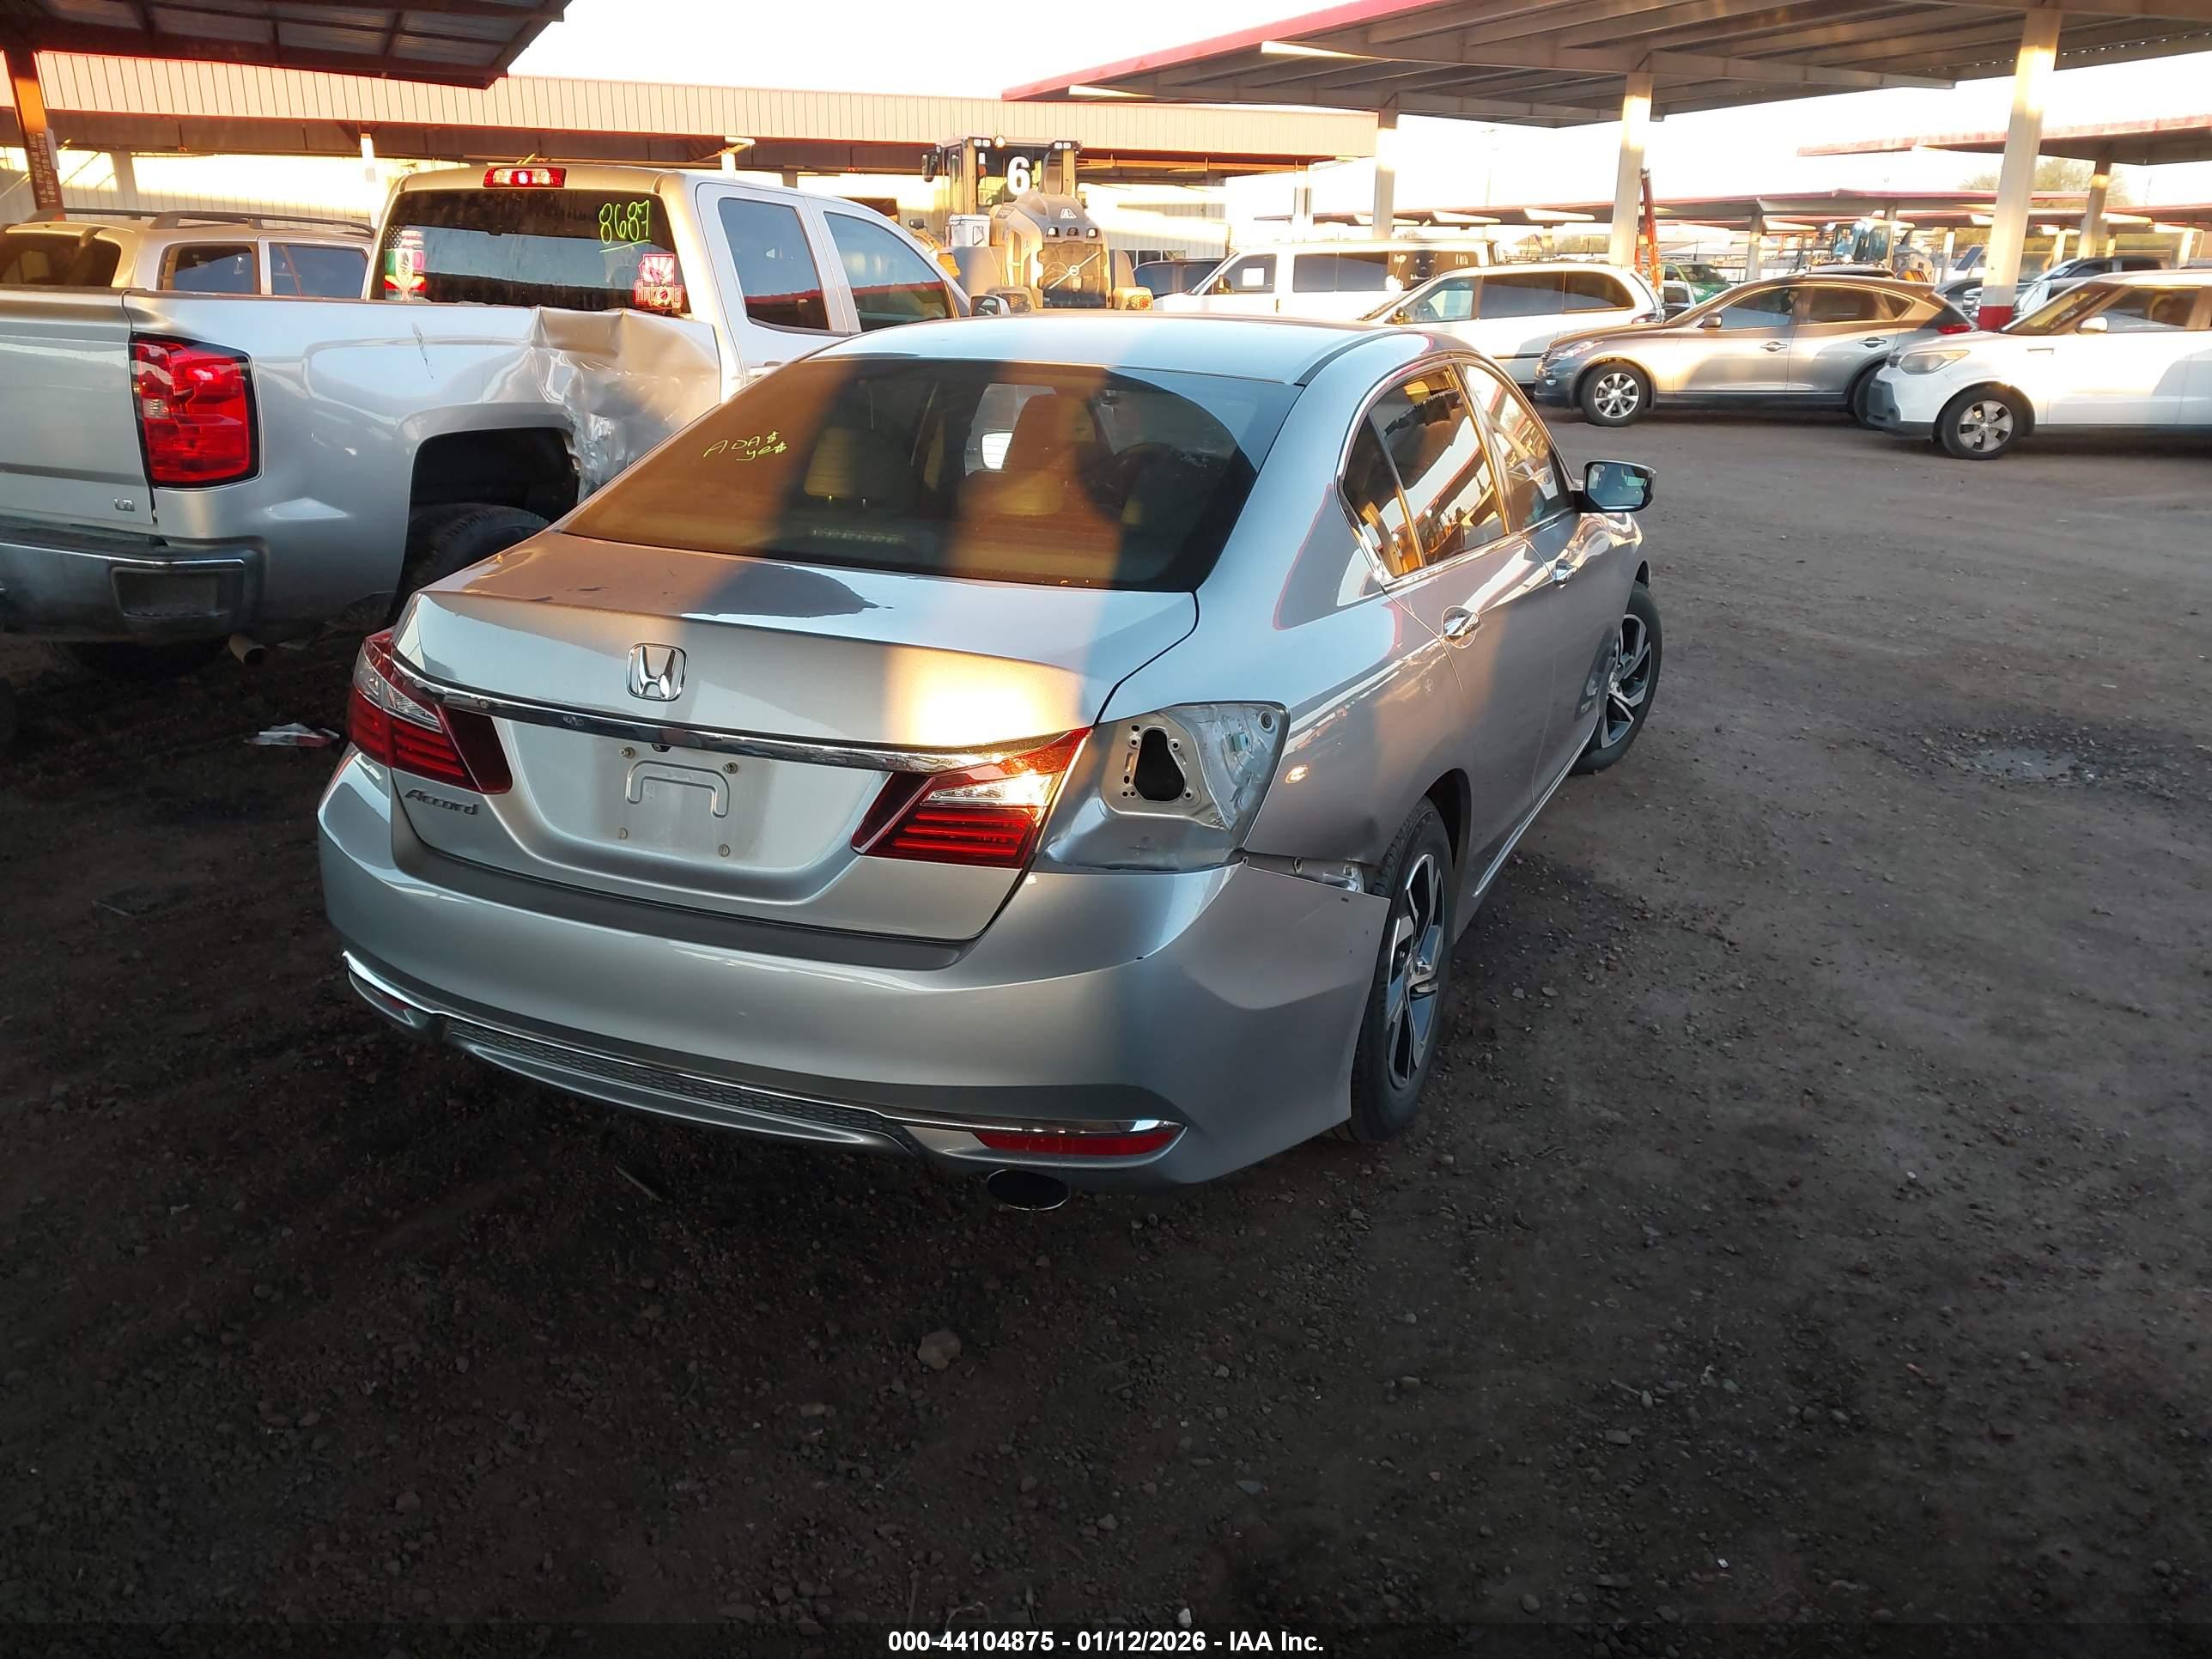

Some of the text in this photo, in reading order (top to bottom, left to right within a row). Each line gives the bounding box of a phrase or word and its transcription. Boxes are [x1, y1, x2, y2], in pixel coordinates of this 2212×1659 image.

[1007, 156, 1030, 196] 6
[599, 199, 649, 245] 8687
[404, 788, 480, 815] Accord
